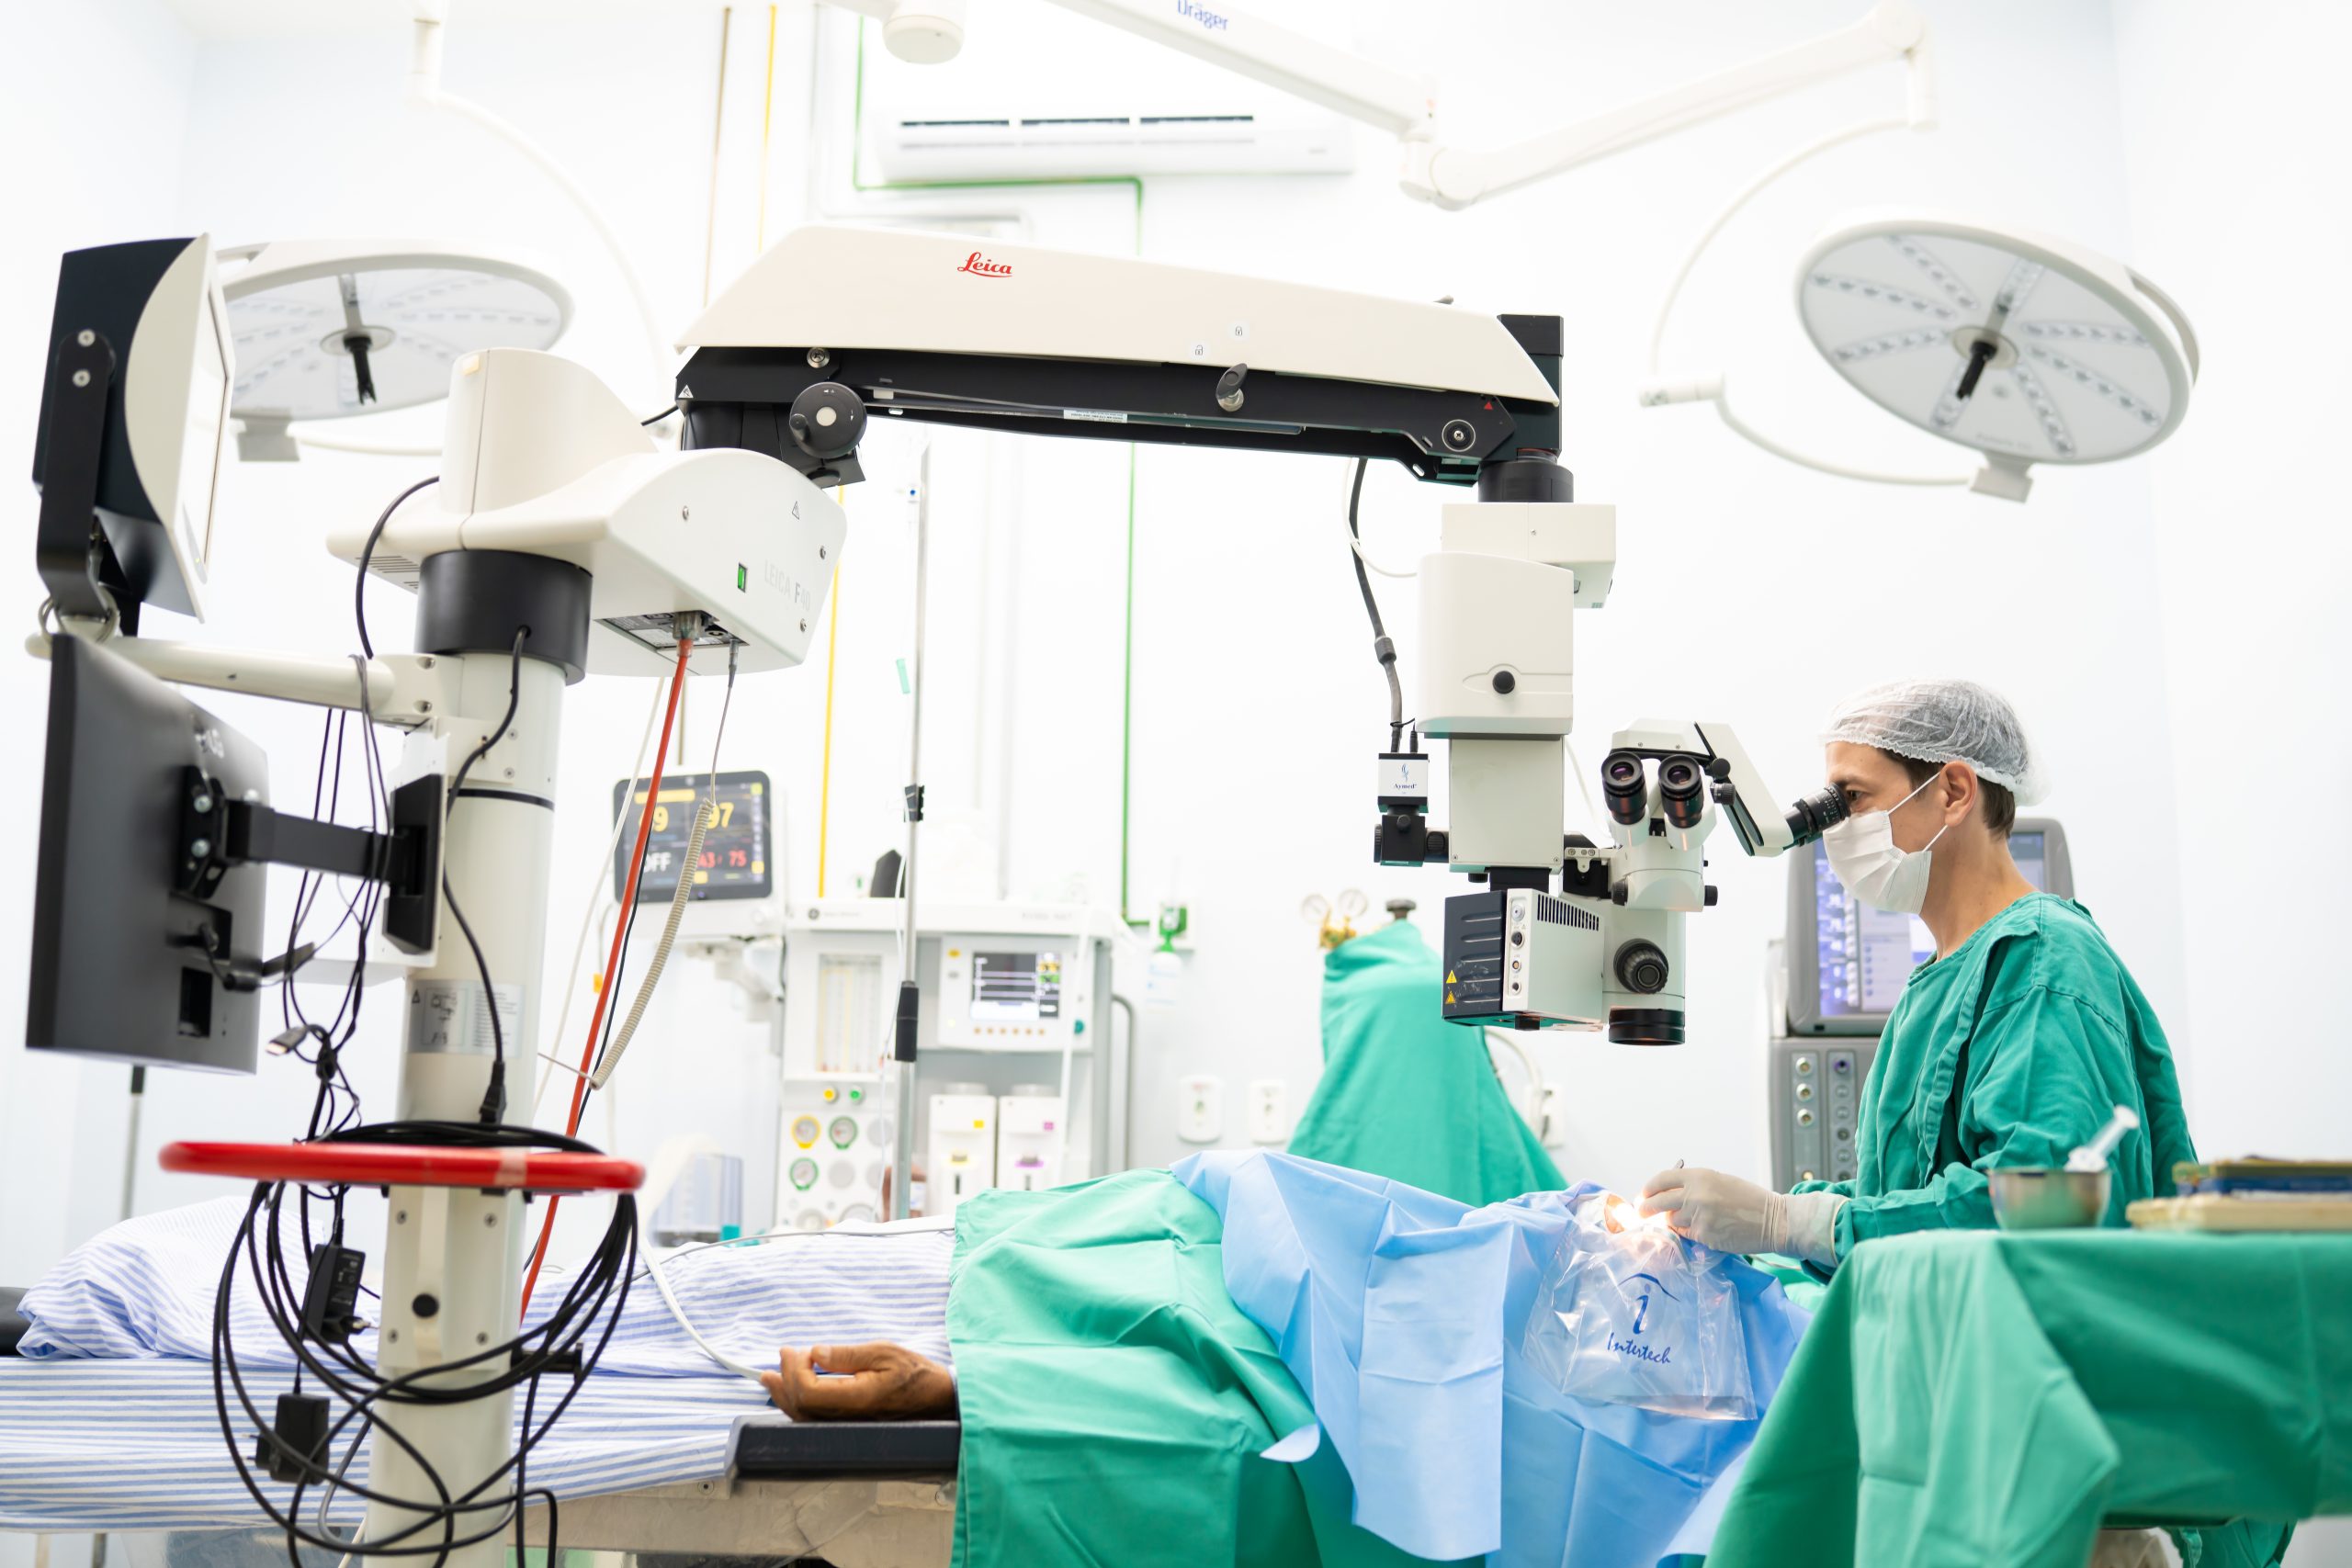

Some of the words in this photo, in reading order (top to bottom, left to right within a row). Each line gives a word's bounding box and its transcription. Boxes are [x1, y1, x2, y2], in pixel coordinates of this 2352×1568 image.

[957, 252, 1012, 277] Leica
[764, 558, 791, 600] LEICA
[1607, 1331, 1671, 1364] Intertech
